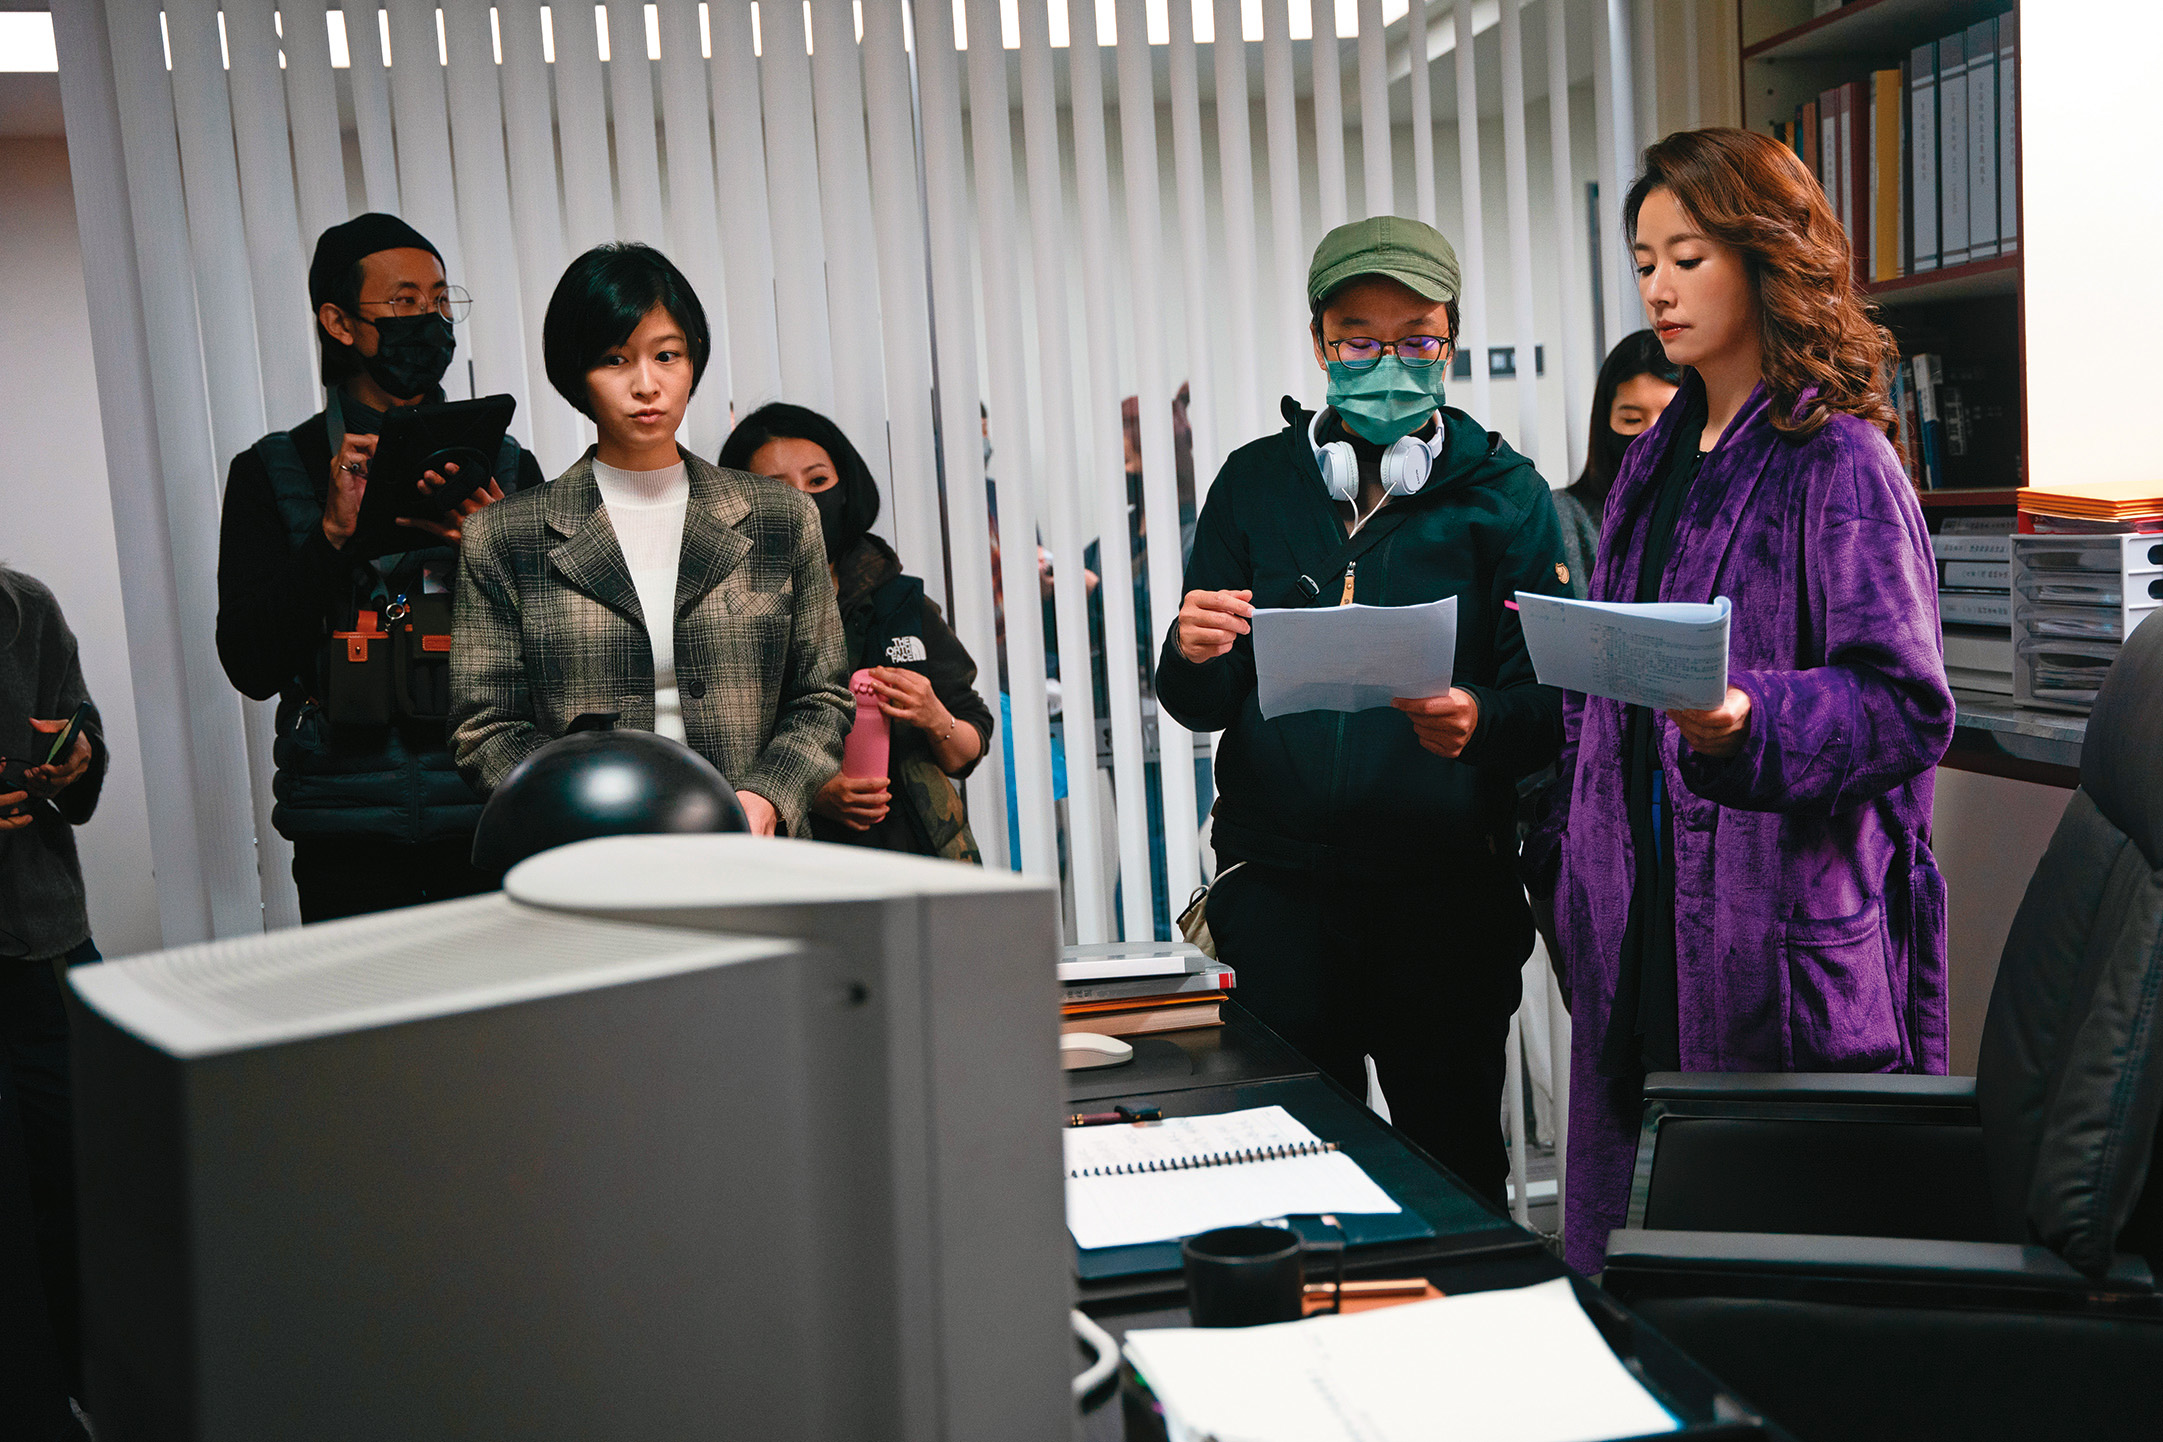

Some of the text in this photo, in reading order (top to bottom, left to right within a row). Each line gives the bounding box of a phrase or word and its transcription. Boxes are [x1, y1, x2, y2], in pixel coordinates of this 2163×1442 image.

[891, 636, 910, 647] THE
[885, 643, 912, 656] ORTH
[892, 653, 914, 664] FACE
